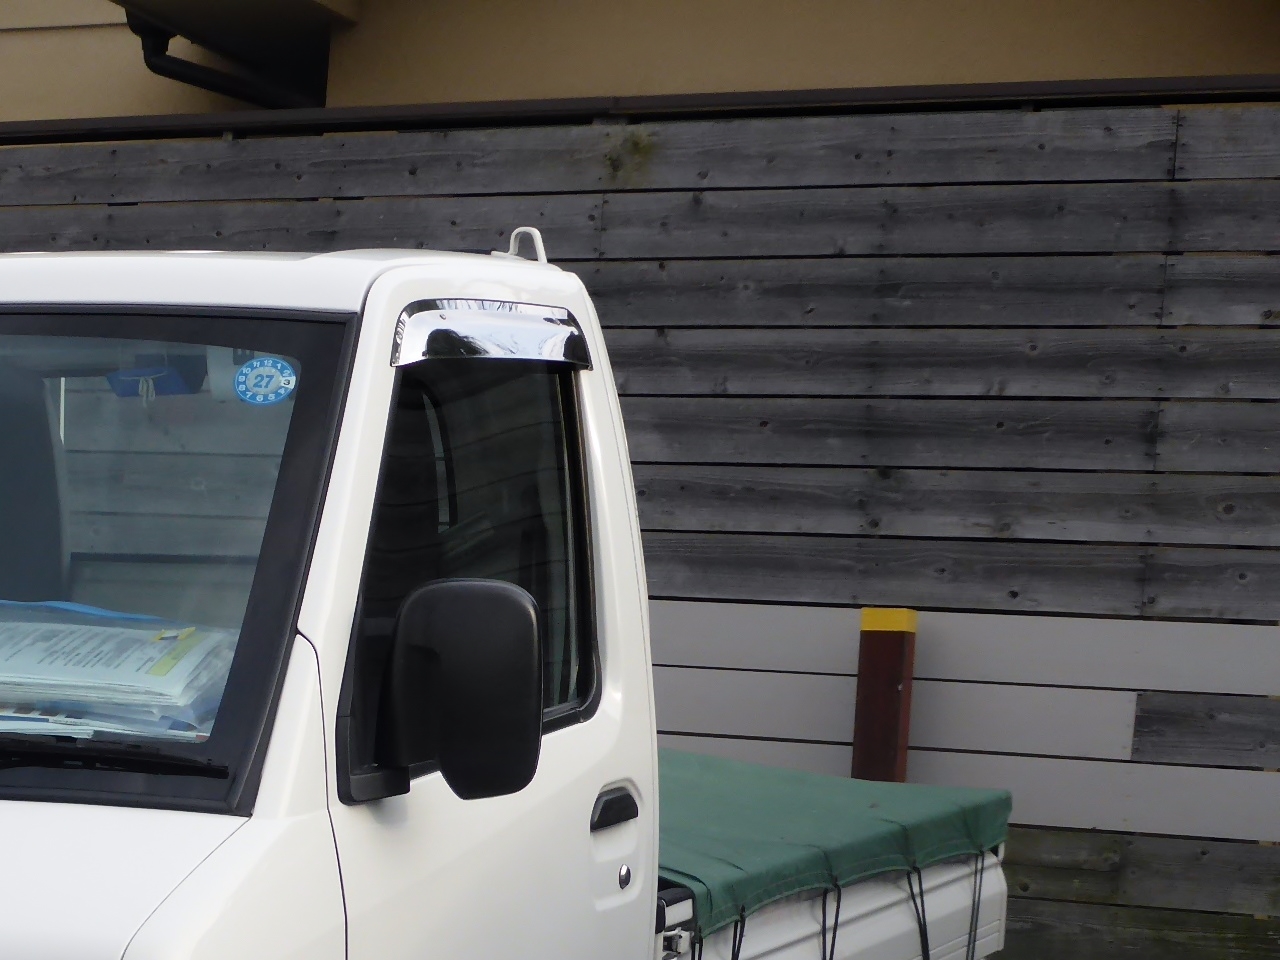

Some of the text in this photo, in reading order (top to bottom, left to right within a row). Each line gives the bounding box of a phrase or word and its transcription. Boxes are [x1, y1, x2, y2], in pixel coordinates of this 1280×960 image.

[263, 359, 273, 367] 12
[282, 369, 291, 377] 2
[253, 374, 275, 388] 27
[255, 394, 264, 402] 6
[267, 393, 276, 401] 5
